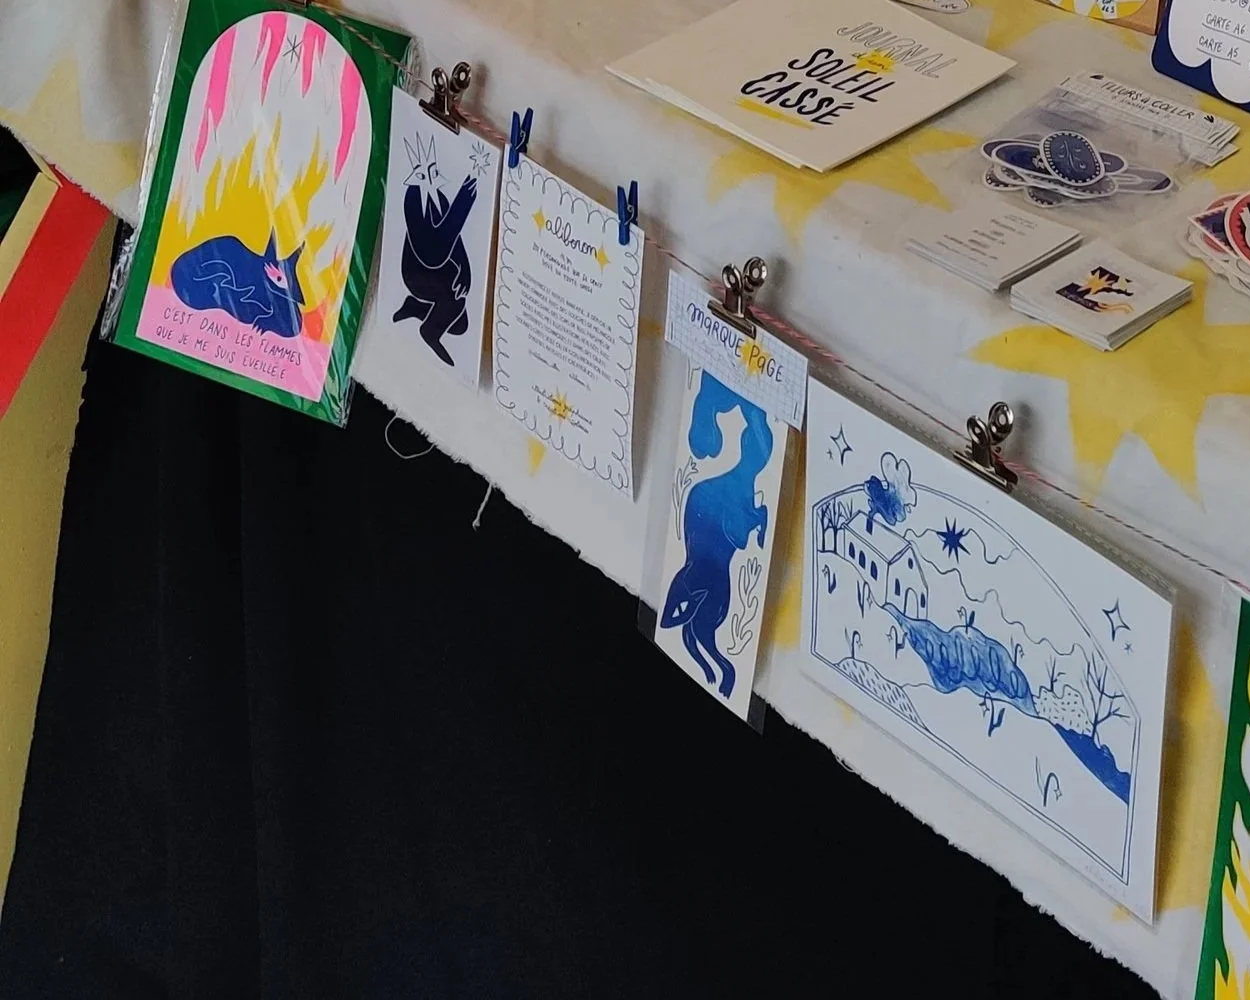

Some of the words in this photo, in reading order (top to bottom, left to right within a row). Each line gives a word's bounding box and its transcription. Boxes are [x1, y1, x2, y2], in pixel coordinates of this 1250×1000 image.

[1198, 35, 1223, 53] CARTE
[1227, 47, 1239, 59] A5
[1205, 13, 1231, 32] CARTE
[1233, 23, 1246, 35] A6
[740, 71, 855, 126] CASSÉ
[788, 48, 896, 103] SOLEIL
[155, 325, 173, 340] QUE
[178, 333, 188, 345] JE
[194, 338, 209, 352] ME
[214, 344, 236, 364] SUIS
[242, 350, 286, 380] ÉVEILLÉE
[163, 307, 194, 325] C'EST
[199, 317, 229, 340] DANS
[235, 331, 254, 348] LES
[259, 338, 302, 366] FLAMMES
